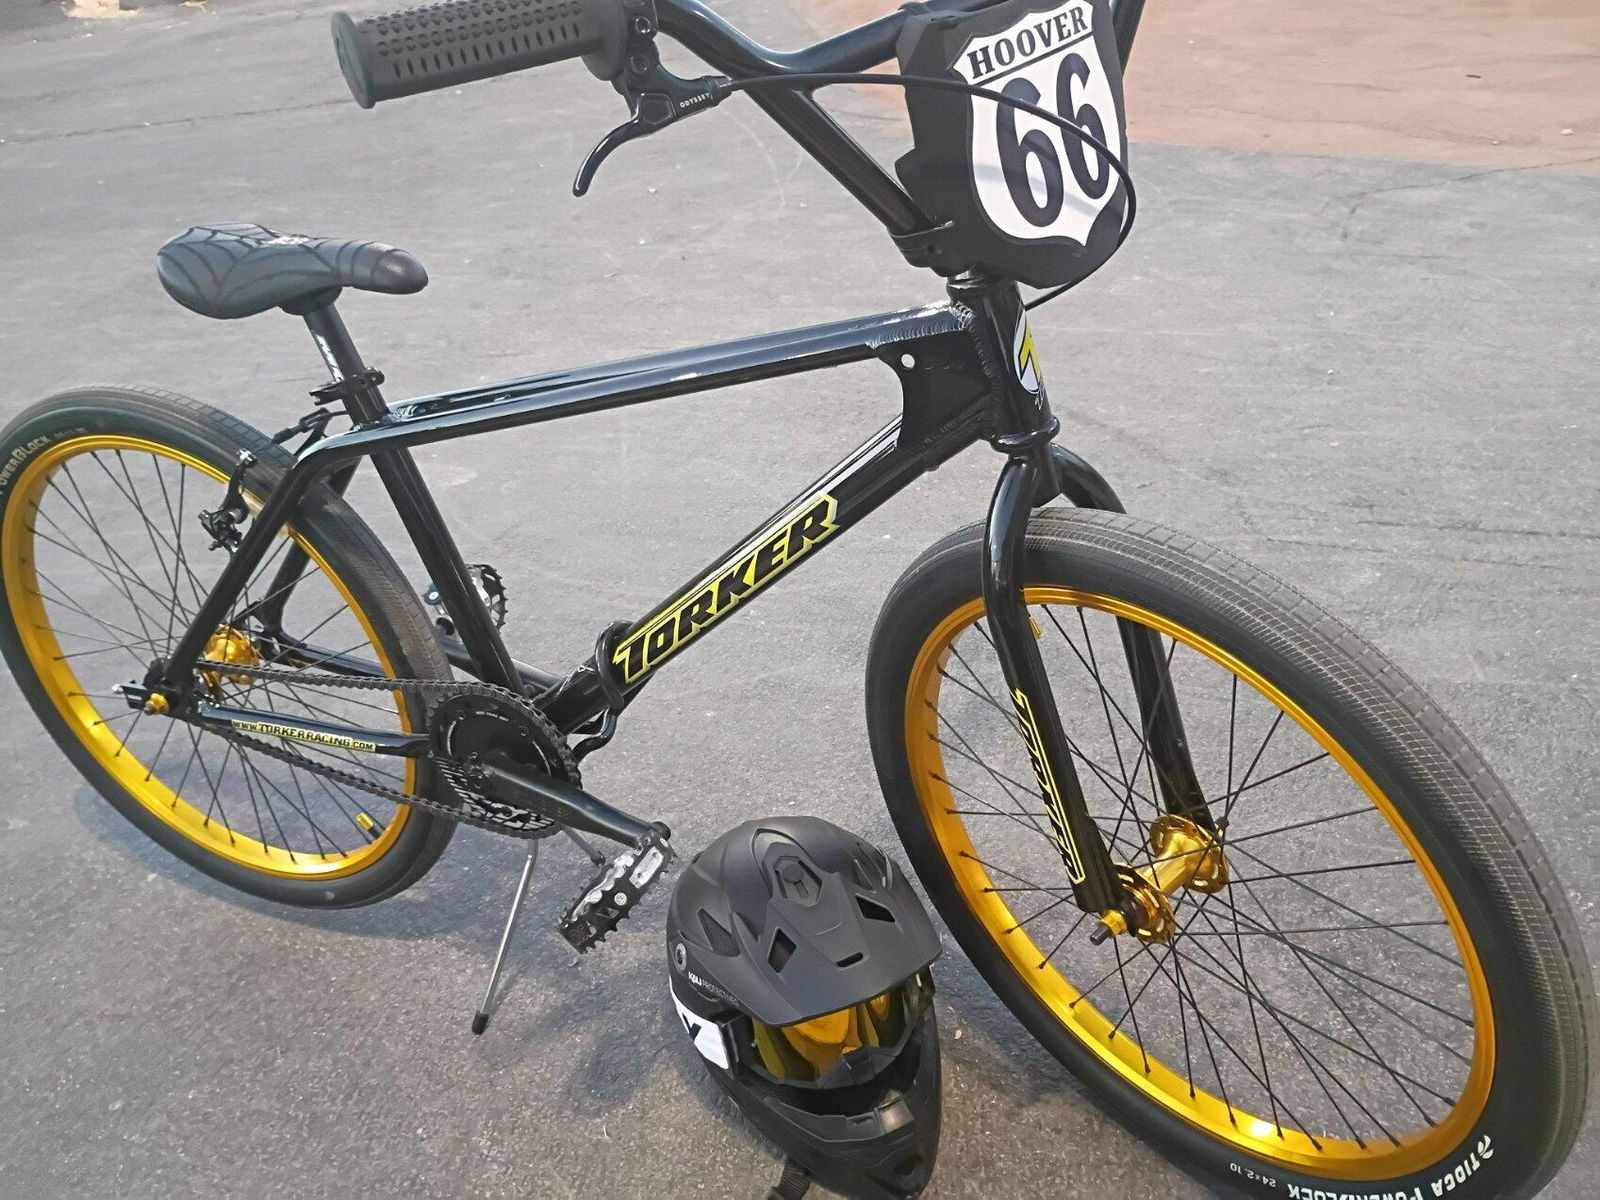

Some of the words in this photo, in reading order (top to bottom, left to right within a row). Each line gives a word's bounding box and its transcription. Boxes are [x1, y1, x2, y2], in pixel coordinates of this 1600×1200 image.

[967, 6, 1088, 79] HOOVER
[680, 92, 711, 108] ODYSSEY
[996, 52, 1110, 228] 66
[0, 435, 51, 495] OWERBLOCK
[613, 494, 839, 684] TORKER
[1431, 1152, 1480, 1197] TIOGA
